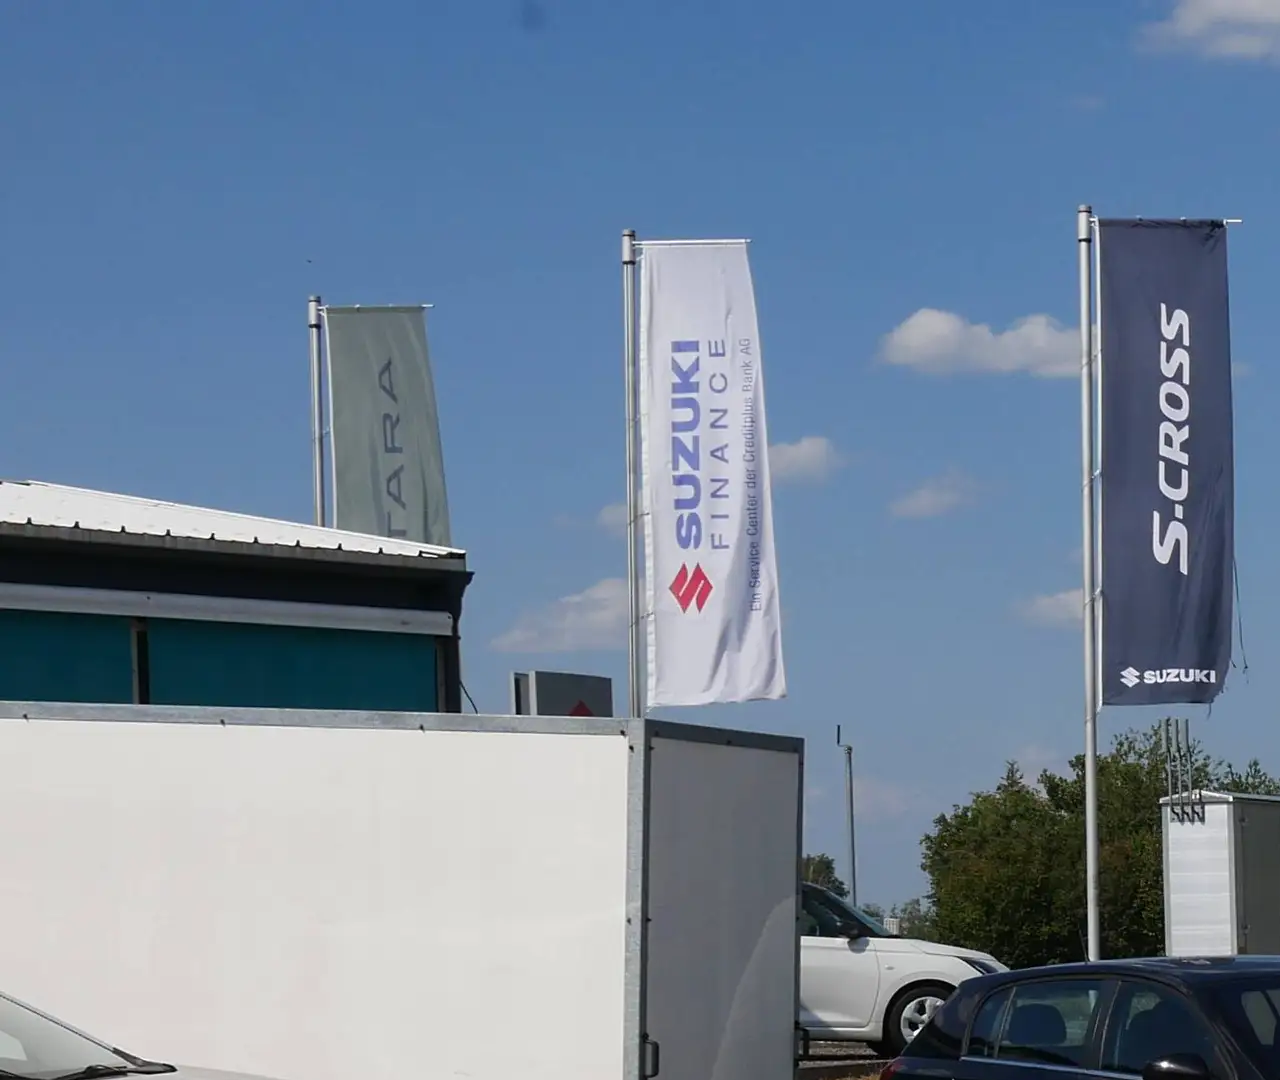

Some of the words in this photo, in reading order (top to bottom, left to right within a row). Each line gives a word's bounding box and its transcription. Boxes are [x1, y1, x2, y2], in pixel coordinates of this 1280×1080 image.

[738, 338, 752, 356] AG
[739, 360, 752, 392] Bank
[670, 340, 702, 550] SUZUKI
[707, 338, 730, 550] FINANCE
[740, 396, 755, 463] Creditplus
[1153, 302, 1190, 576] S-CROSS
[743, 467, 756, 489] der
[745, 495, 758, 536] Center
[747, 541, 761, 589] Service
[749, 592, 762, 612] Ein
[1143, 668, 1216, 684] SUZUKI
